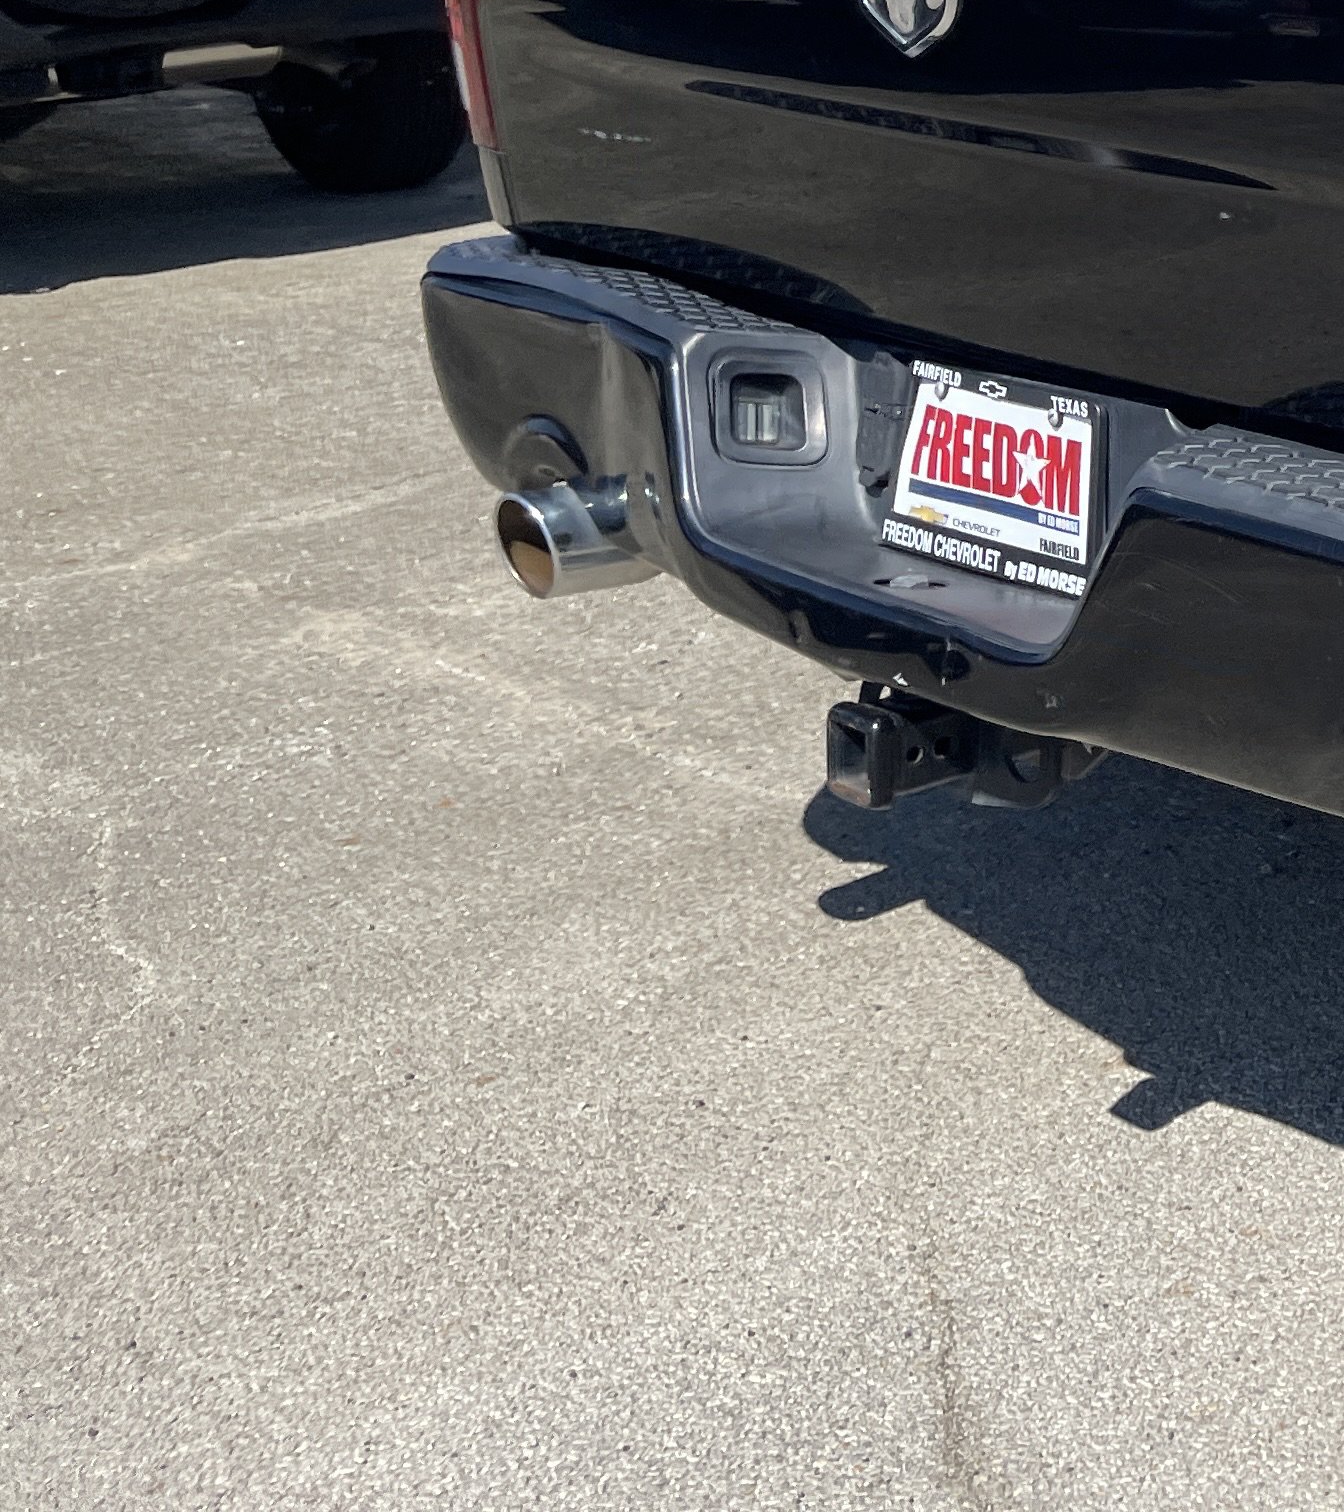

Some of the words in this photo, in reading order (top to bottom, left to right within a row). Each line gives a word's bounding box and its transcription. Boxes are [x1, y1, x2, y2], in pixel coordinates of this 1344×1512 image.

[912, 360, 962, 387] FAIRFIELD
[1050, 395, 1089, 418] TEXAS
[911, 404, 1082, 516] FREEDOM
[952, 518, 1001, 537] CHEVROLET
[882, 519, 932, 554] FREEDOM
[933, 535, 1001, 573] CHEVROLET
[1018, 561, 1037, 583] ED
[1037, 566, 1087, 596] MORSE
[1039, 538, 1080, 561] FAIRFIELD
